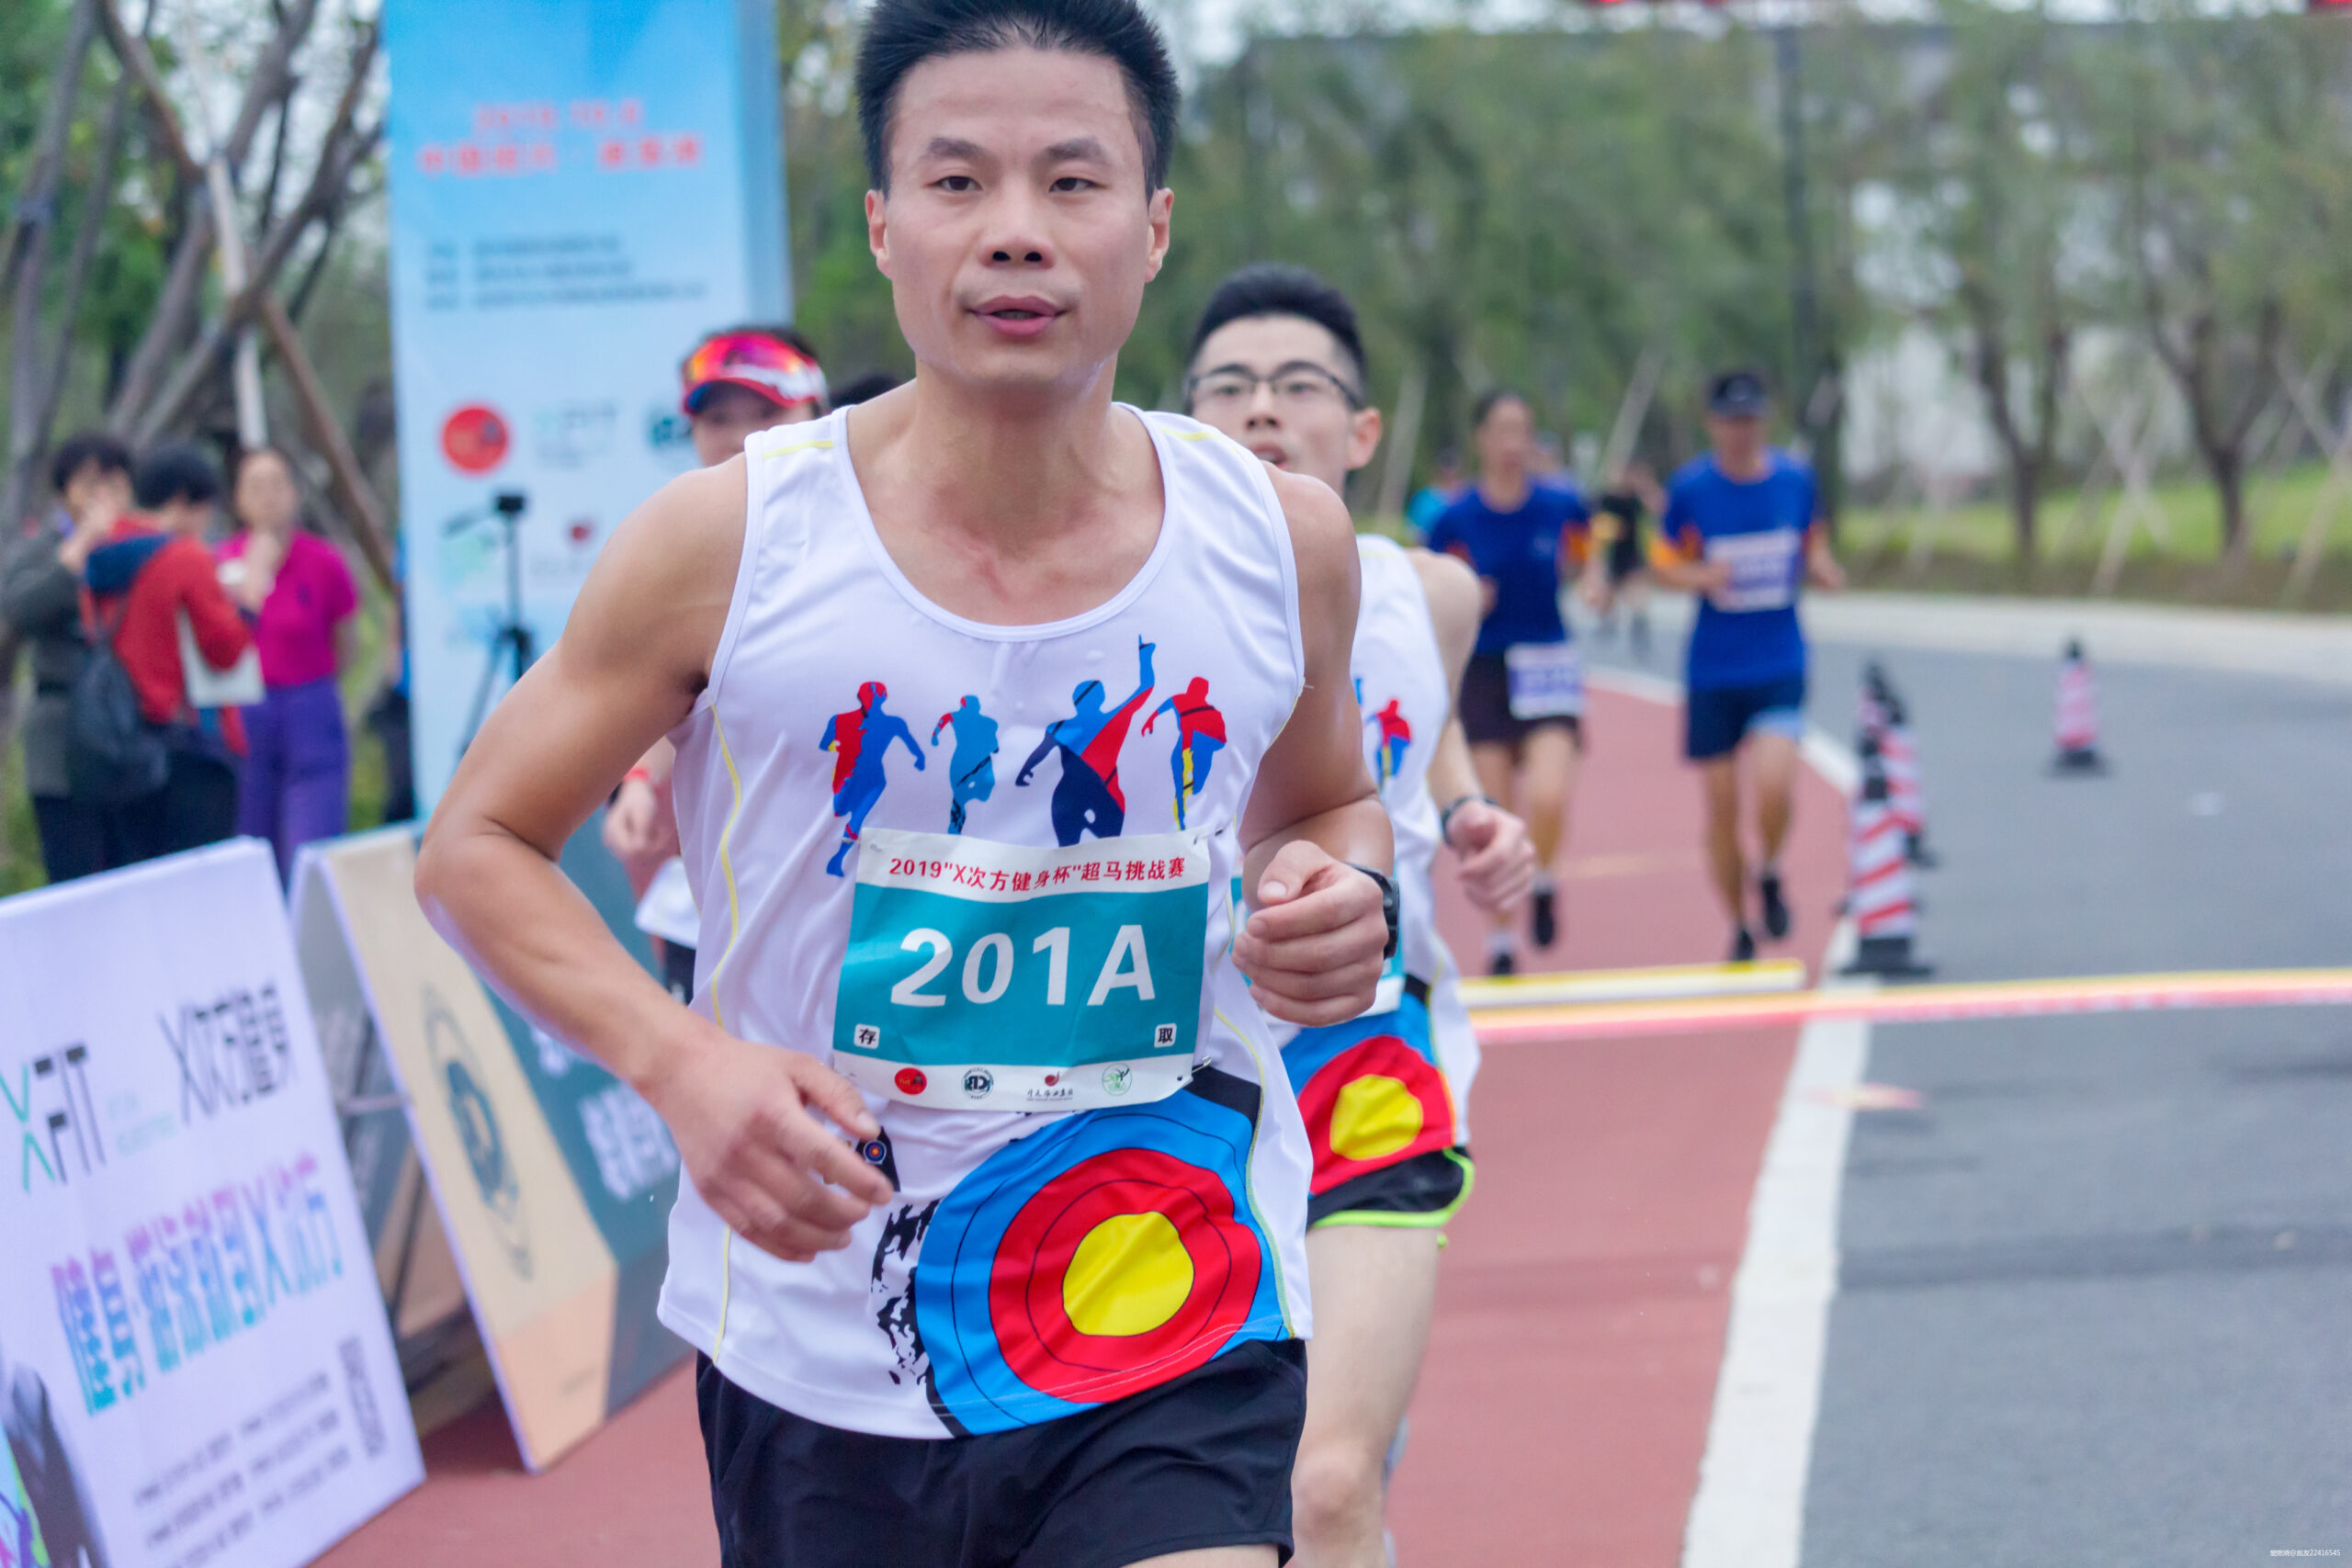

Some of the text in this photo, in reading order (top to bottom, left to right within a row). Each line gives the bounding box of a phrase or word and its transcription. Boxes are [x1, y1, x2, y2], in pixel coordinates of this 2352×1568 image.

[890, 924, 1156, 1007] 201A
[858, 1028, 876, 1045] 存
[1158, 1027, 1174, 1043] 取
